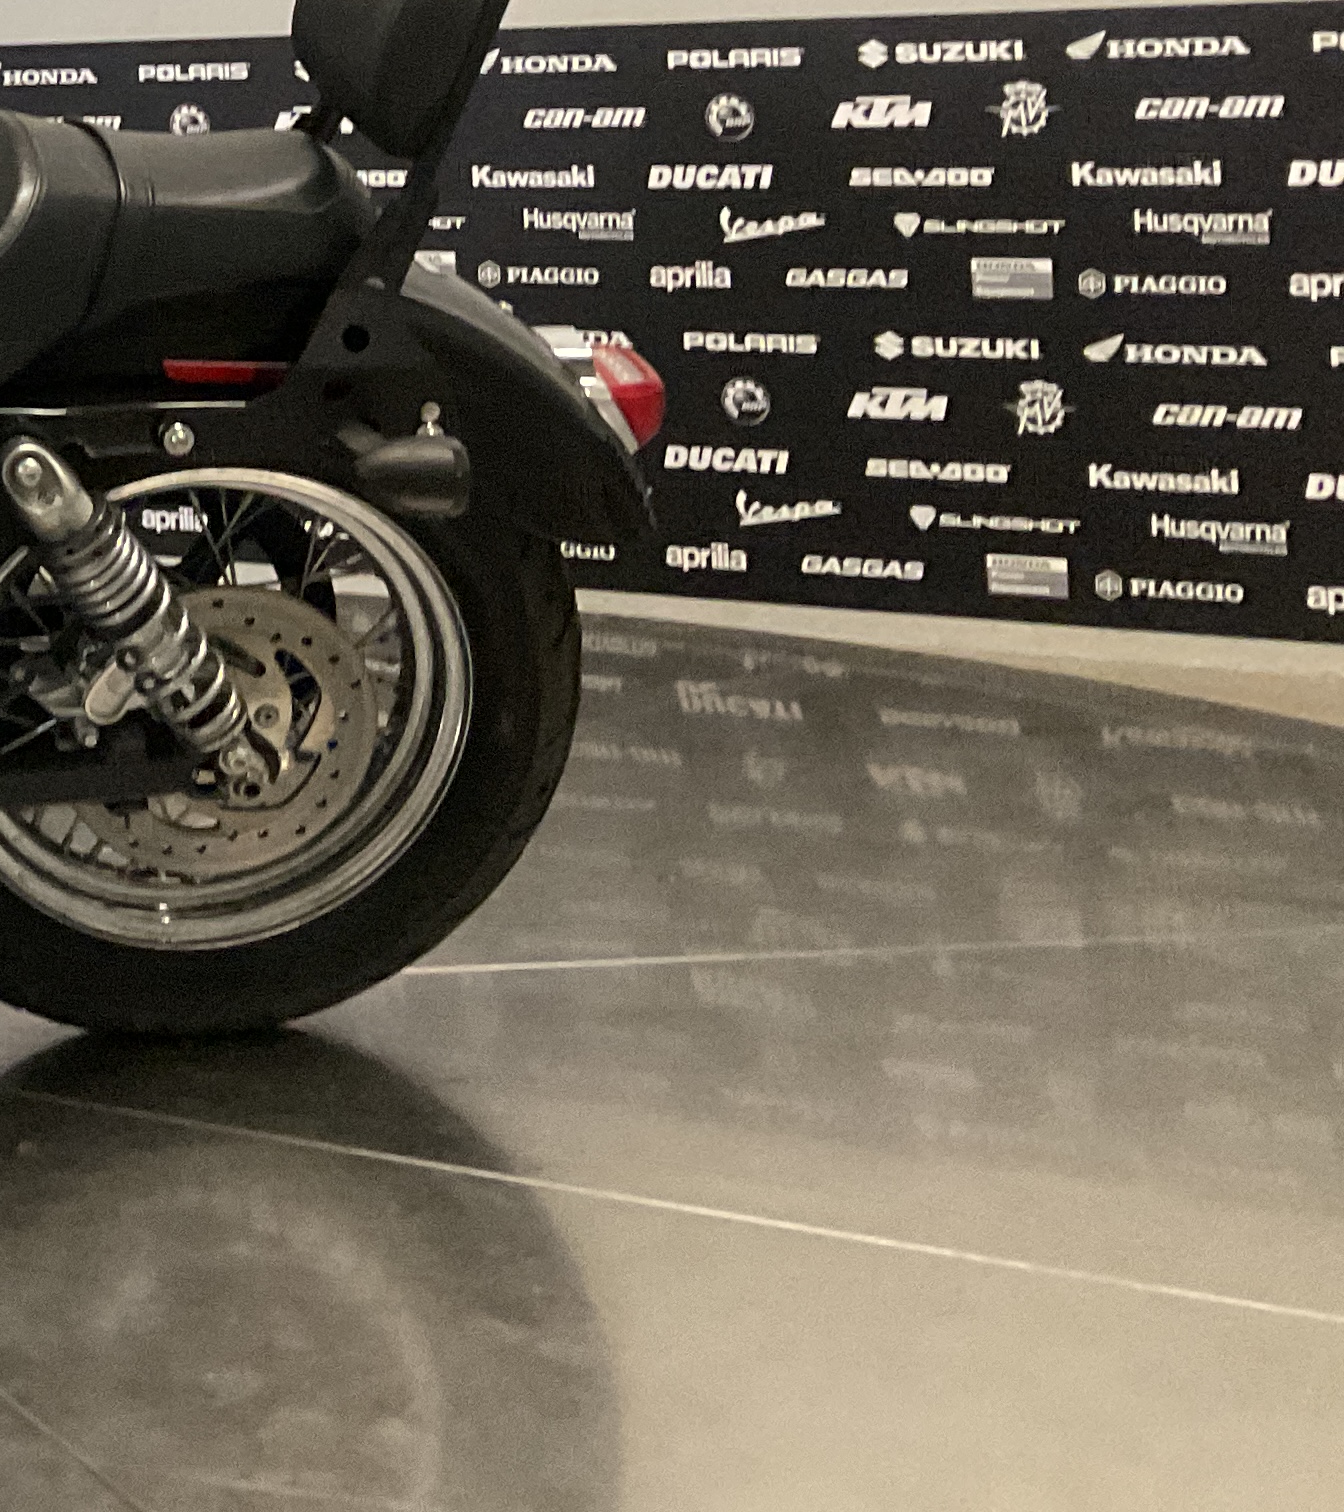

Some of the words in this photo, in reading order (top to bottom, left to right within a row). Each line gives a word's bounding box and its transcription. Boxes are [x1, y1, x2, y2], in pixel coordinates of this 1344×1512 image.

[668, 47, 803, 69] POLARIS
[896, 40, 1023, 63] SUZUKI
[1107, 36, 1250, 58] HONDA
[139, 62, 248, 82] POLARIS
[501, 54, 617, 74] HONDA
[3, 68, 97, 86] HONDA
[524, 107, 645, 128] can-am
[832, 95, 932, 128] KTM
[1135, 96, 1284, 119] can-am
[472, 165, 594, 188] Kawasaki
[648, 165, 773, 189] DUCATI
[1072, 160, 1221, 186] Kawasaki
[523, 208, 634, 235] Husqvarna
[720, 206, 824, 243] Vespa
[1134, 208, 1272, 238] Husqvarna
[508, 267, 599, 284] PIAGGIO
[650, 261, 731, 292] aprilia
[786, 269, 908, 288] GASGAS
[1114, 276, 1226, 294] PIAGGIO
[684, 332, 817, 353] POLARIS
[912, 336, 1039, 359] SUZUKI
[1126, 344, 1266, 365] HONDA
[847, 387, 947, 421] KTM
[1153, 404, 1302, 429] can-am
[664, 445, 789, 474] DUCATI
[1089, 463, 1238, 494] Kawasaki
[736, 490, 840, 526] Vespa
[1151, 514, 1290, 544] Husqvarna
[666, 542, 746, 572] aprilia
[801, 555, 923, 580] GASGAS
[1131, 578, 1243, 602] PIAGGIO
